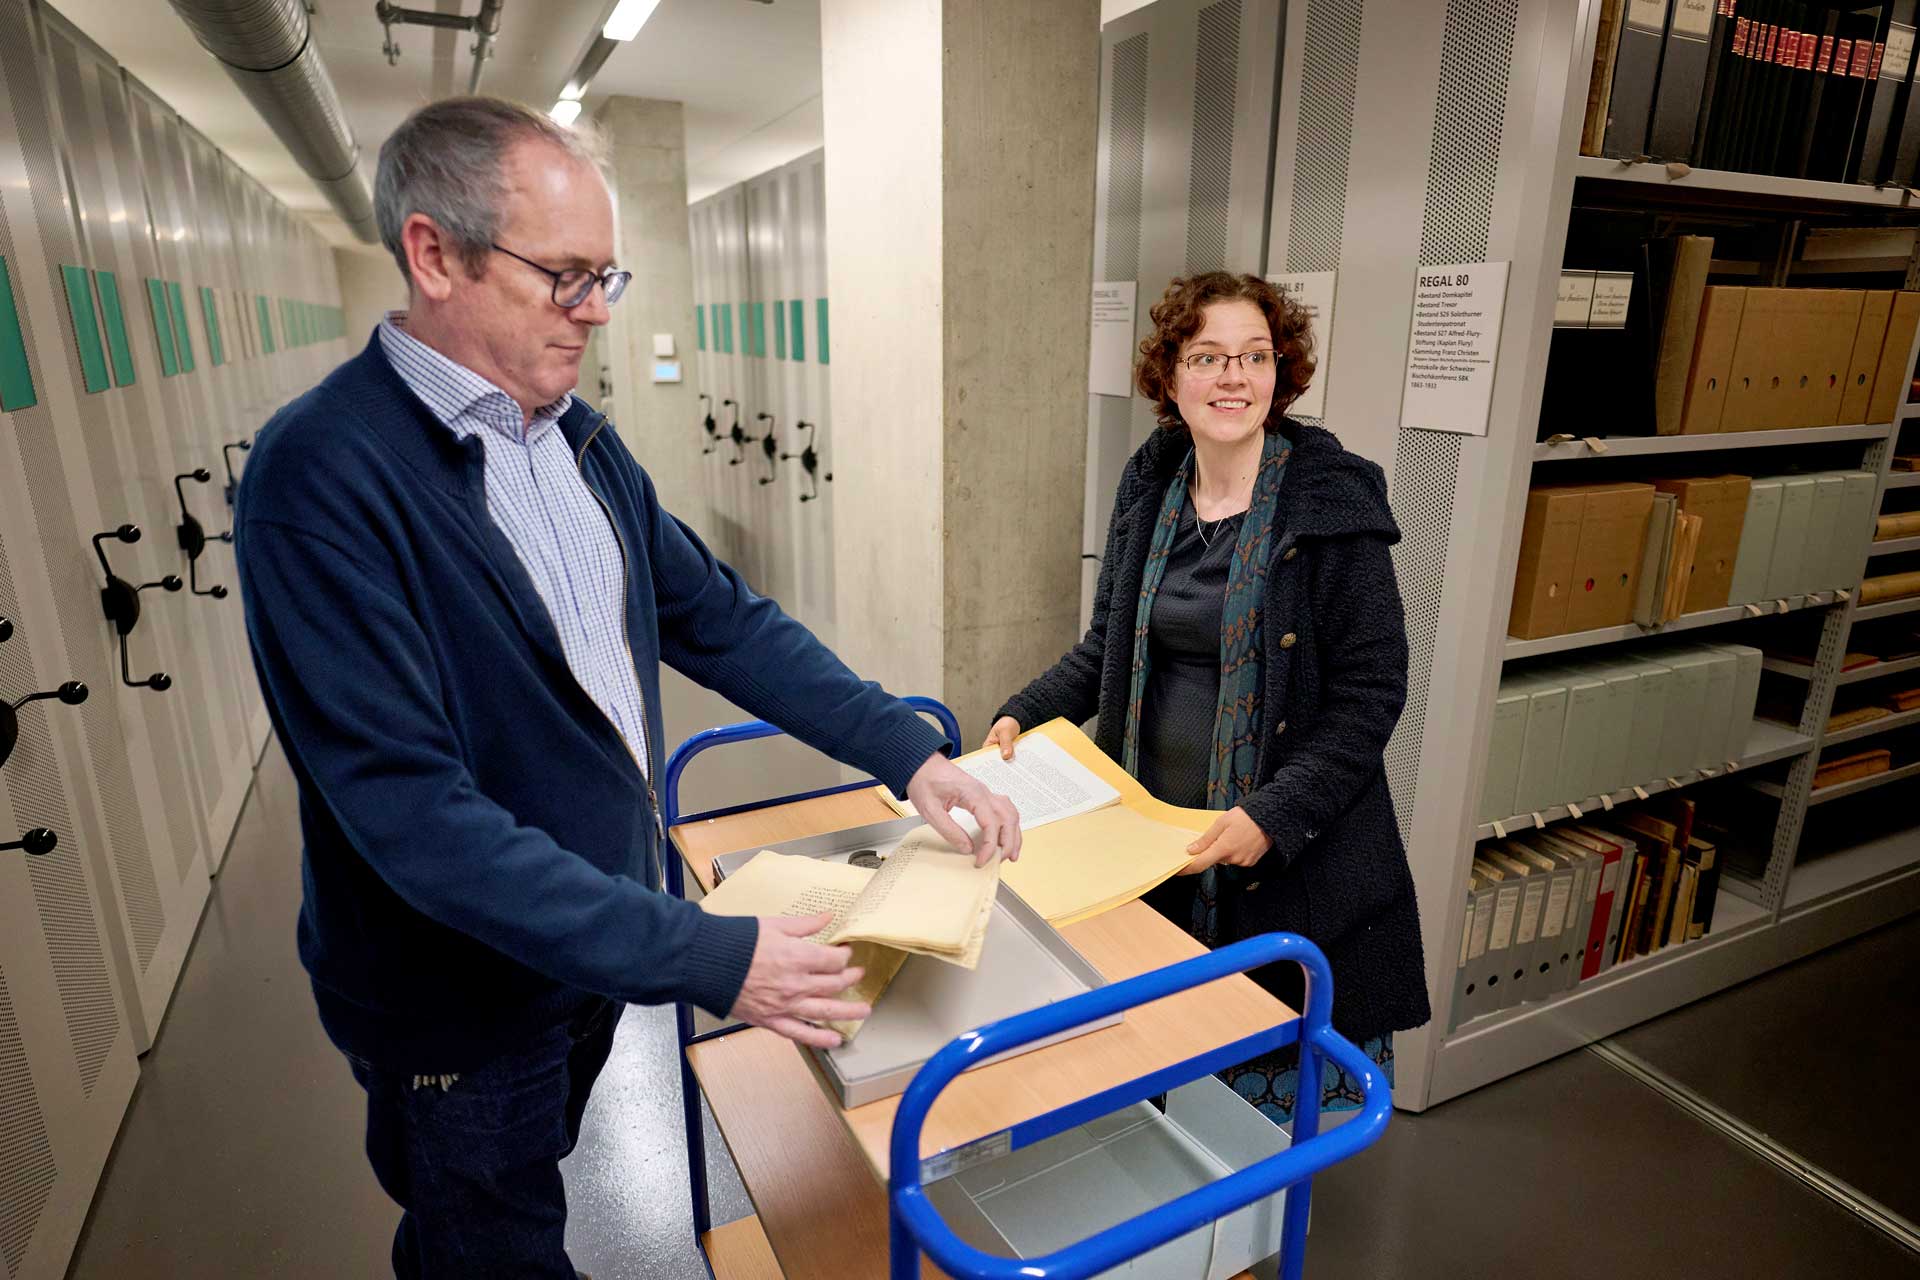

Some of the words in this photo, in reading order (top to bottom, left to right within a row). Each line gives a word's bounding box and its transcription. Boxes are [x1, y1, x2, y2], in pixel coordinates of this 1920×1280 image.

[1419, 275, 1453, 287] REGAL
[1456, 274, 1469, 286] 80
[1442, 291, 1473, 299] Domkapitel
[1414, 348, 1441, 356] Sammlung
[1449, 364, 1476, 372] Schweizer
